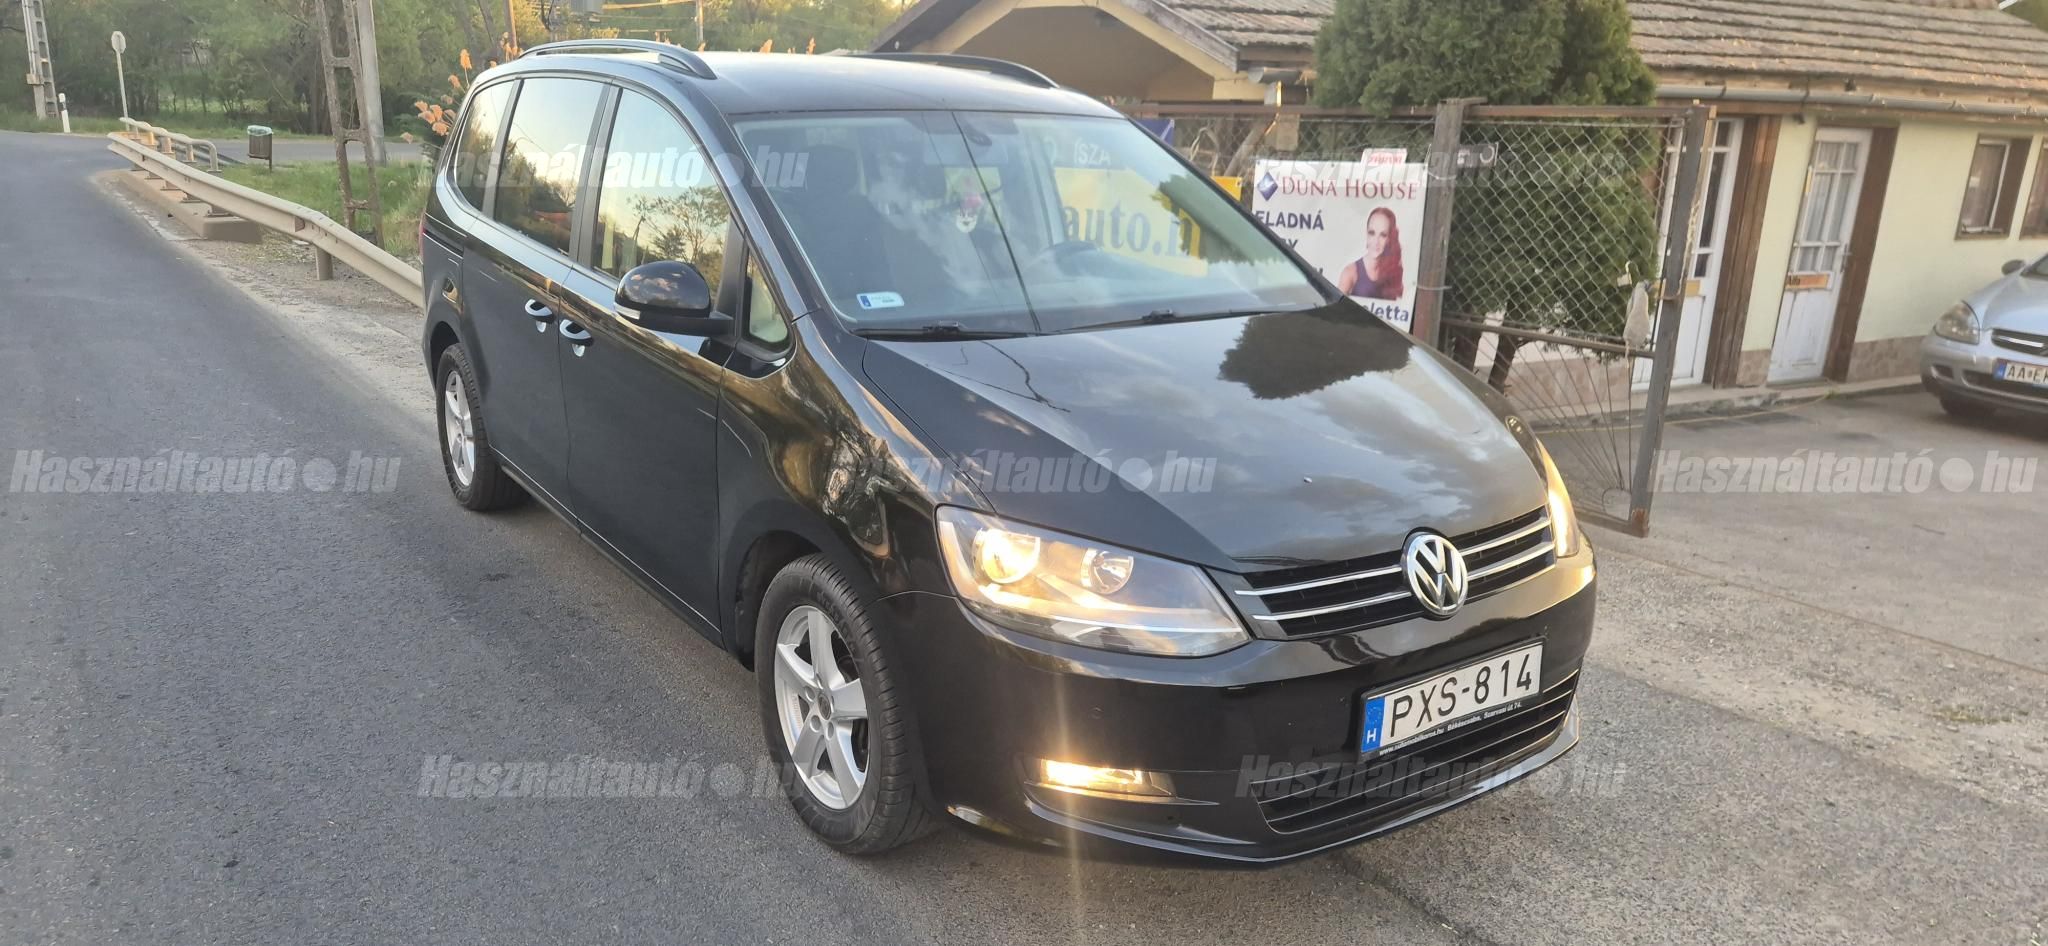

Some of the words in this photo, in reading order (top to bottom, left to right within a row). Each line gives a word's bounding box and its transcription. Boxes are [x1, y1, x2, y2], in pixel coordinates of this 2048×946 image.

[1282, 176, 1337, 197] DUNA
[1346, 179, 1417, 200] HOUSE
[1390, 653, 1533, 738] PXS-814
[1366, 728, 1377, 744] H
